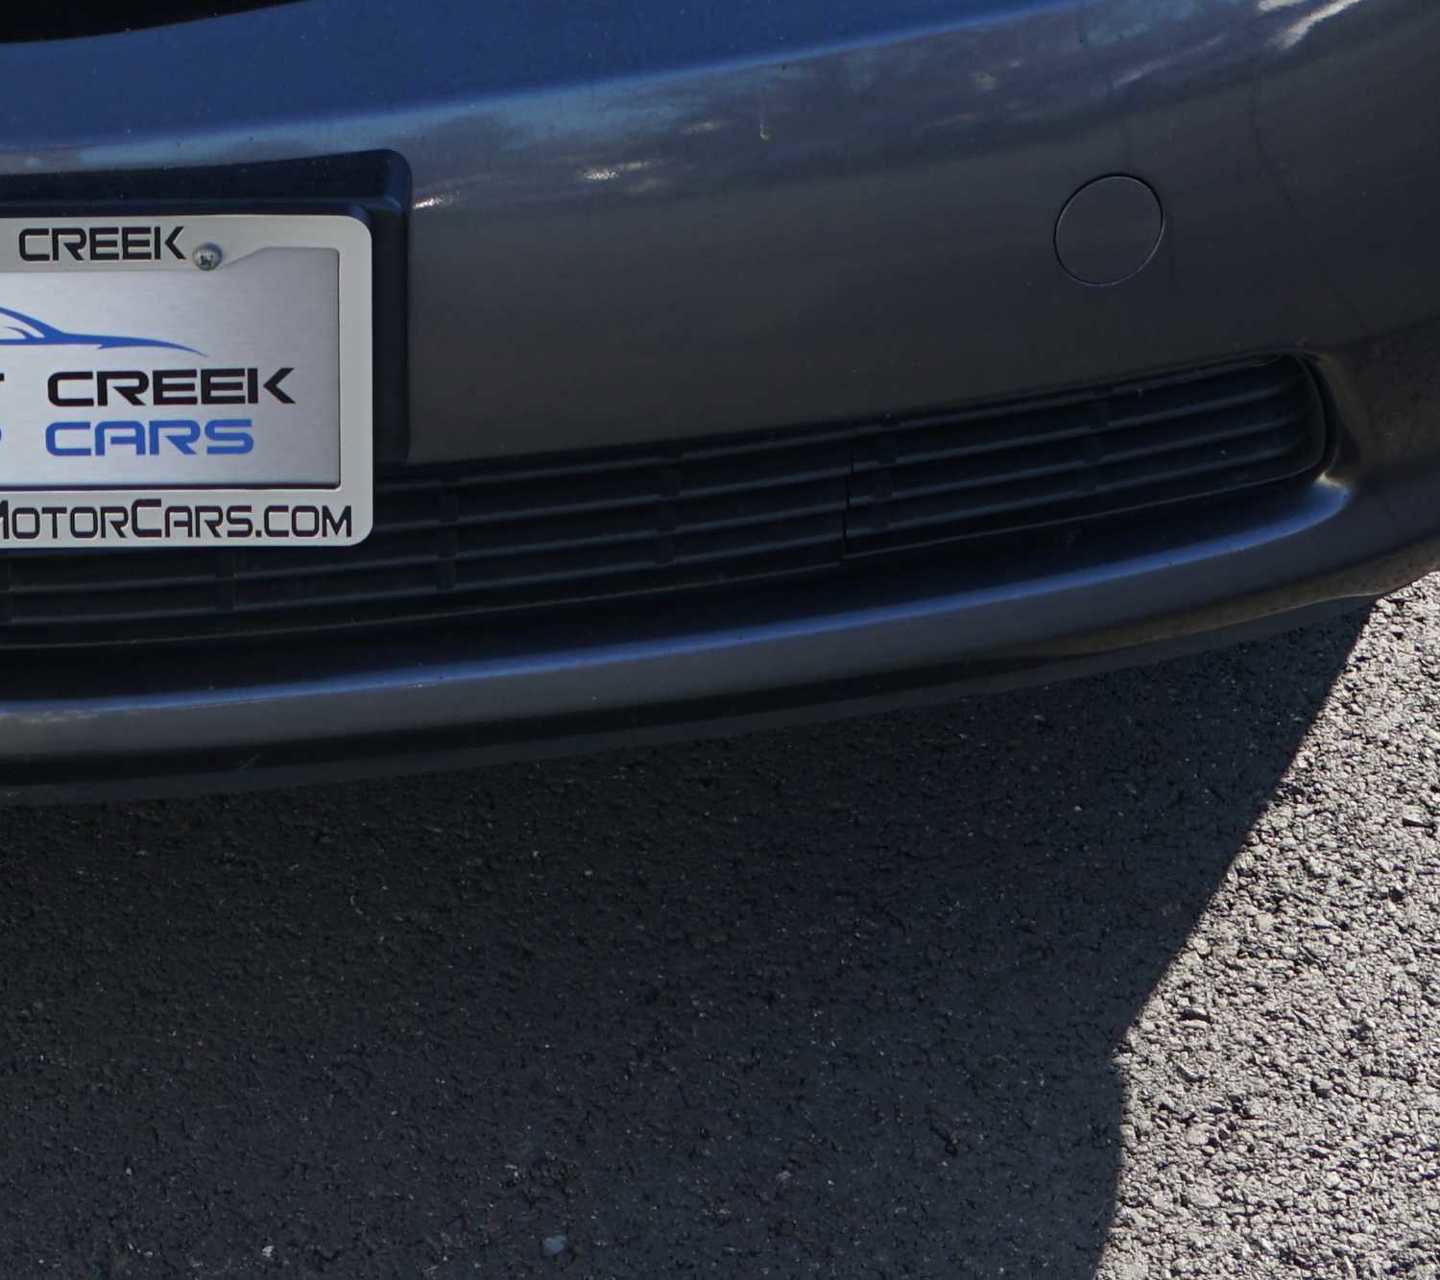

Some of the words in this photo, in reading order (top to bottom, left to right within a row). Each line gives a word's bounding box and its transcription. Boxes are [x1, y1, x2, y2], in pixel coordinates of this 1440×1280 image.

[18, 226, 187, 262] CREEK
[47, 367, 296, 407] CREEK
[45, 418, 254, 457] CARS
